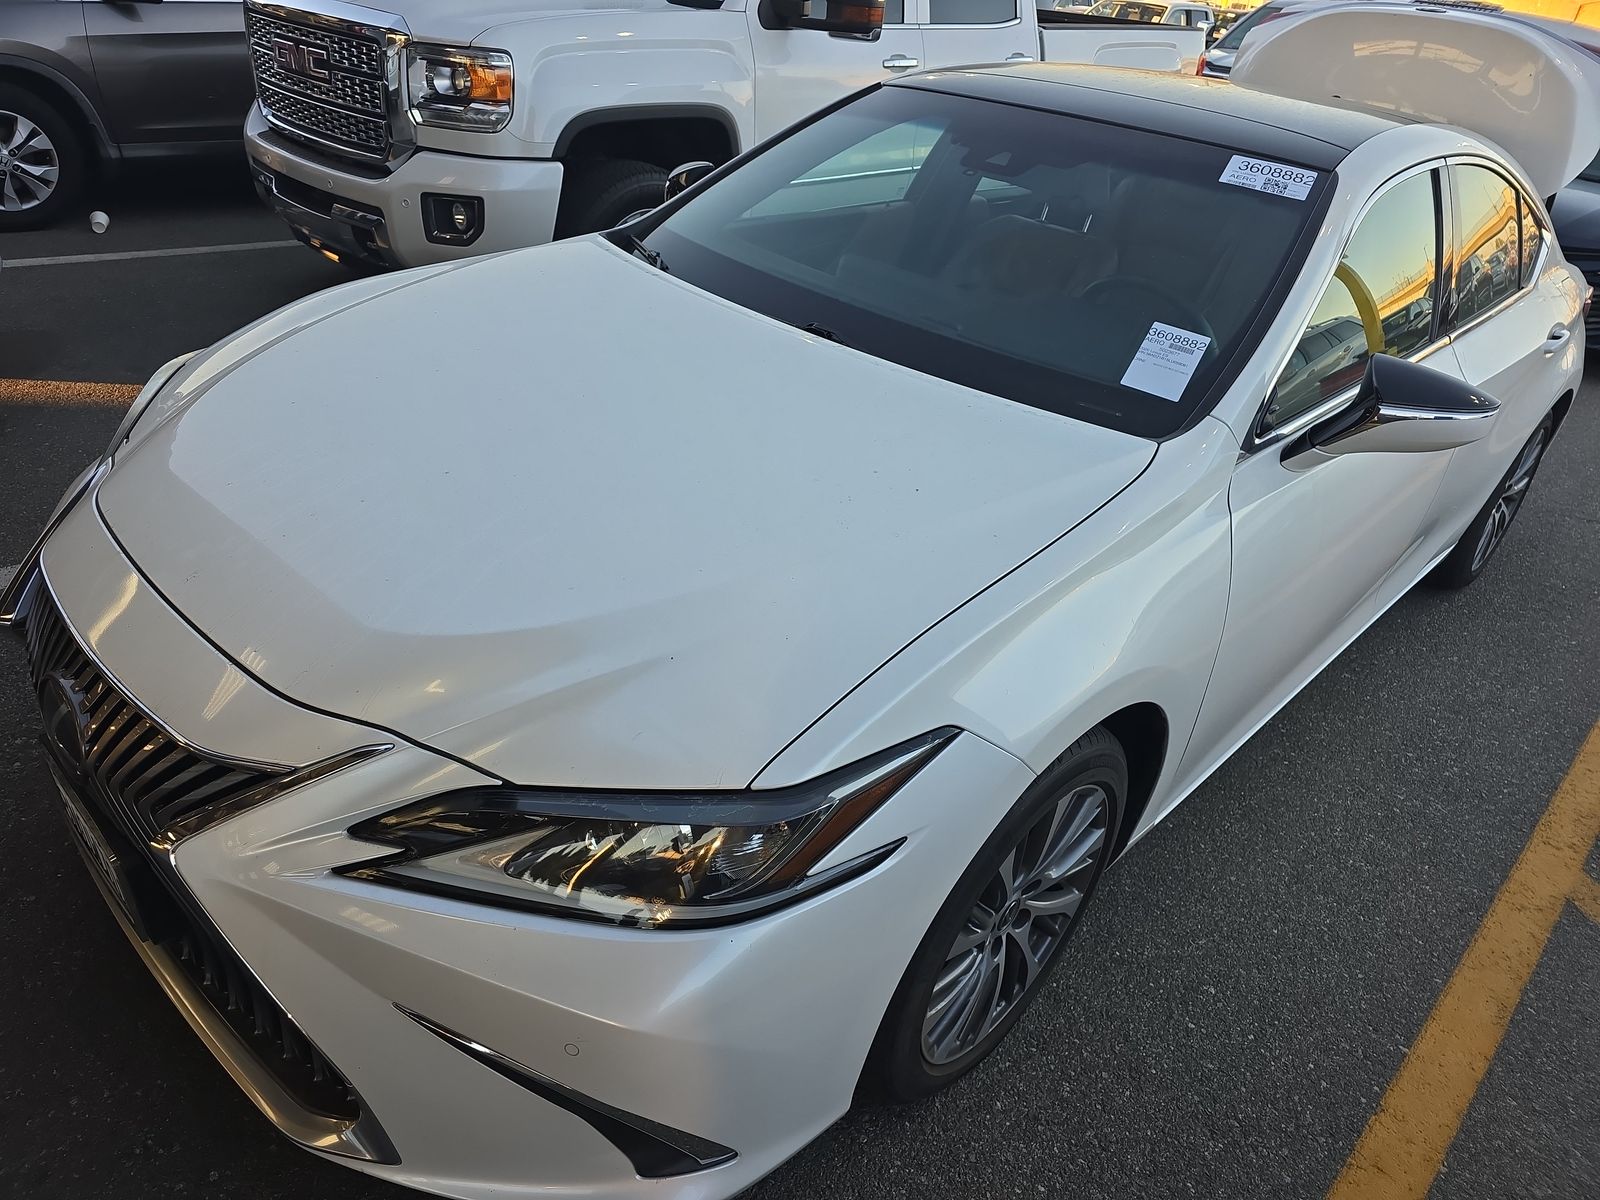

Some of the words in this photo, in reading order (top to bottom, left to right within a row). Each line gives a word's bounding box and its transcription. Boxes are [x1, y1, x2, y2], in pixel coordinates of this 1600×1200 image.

[272, 38, 329, 79] GMC
[1229, 173, 1257, 183] AERO
[1238, 160, 1316, 186] 3608882
[1146, 336, 1165, 345] AERO
[1148, 327, 1207, 350] 3608882
